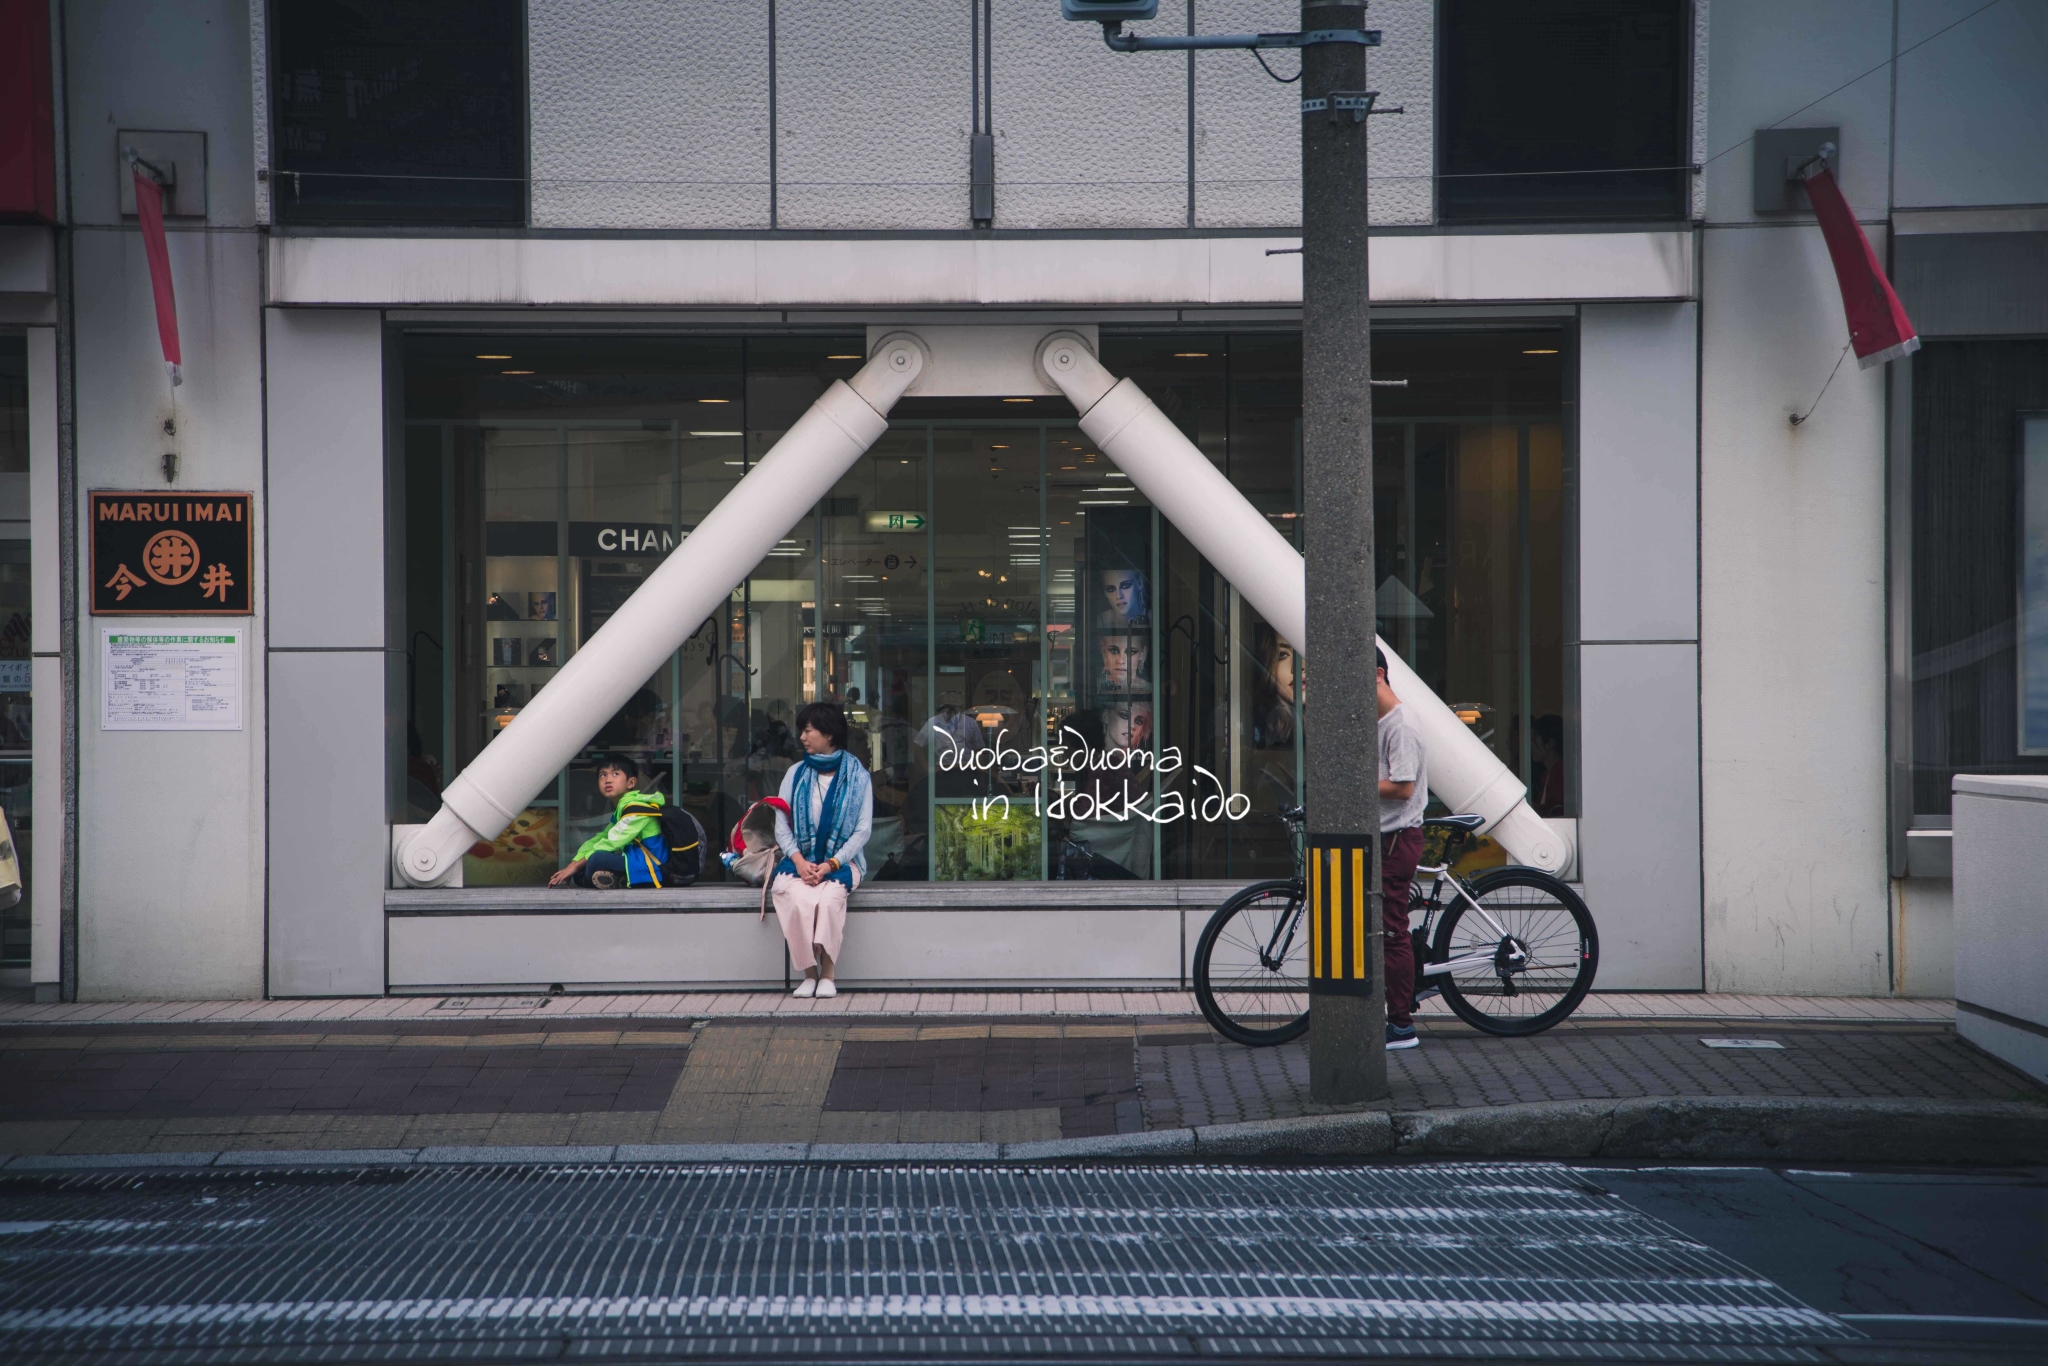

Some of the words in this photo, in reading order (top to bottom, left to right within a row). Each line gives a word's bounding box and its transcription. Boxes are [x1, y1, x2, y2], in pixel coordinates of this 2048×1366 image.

[99, 502, 179, 522] MARUI
[186, 502, 242, 522] IMAI
[830, 557, 881, 567] エレベーター
